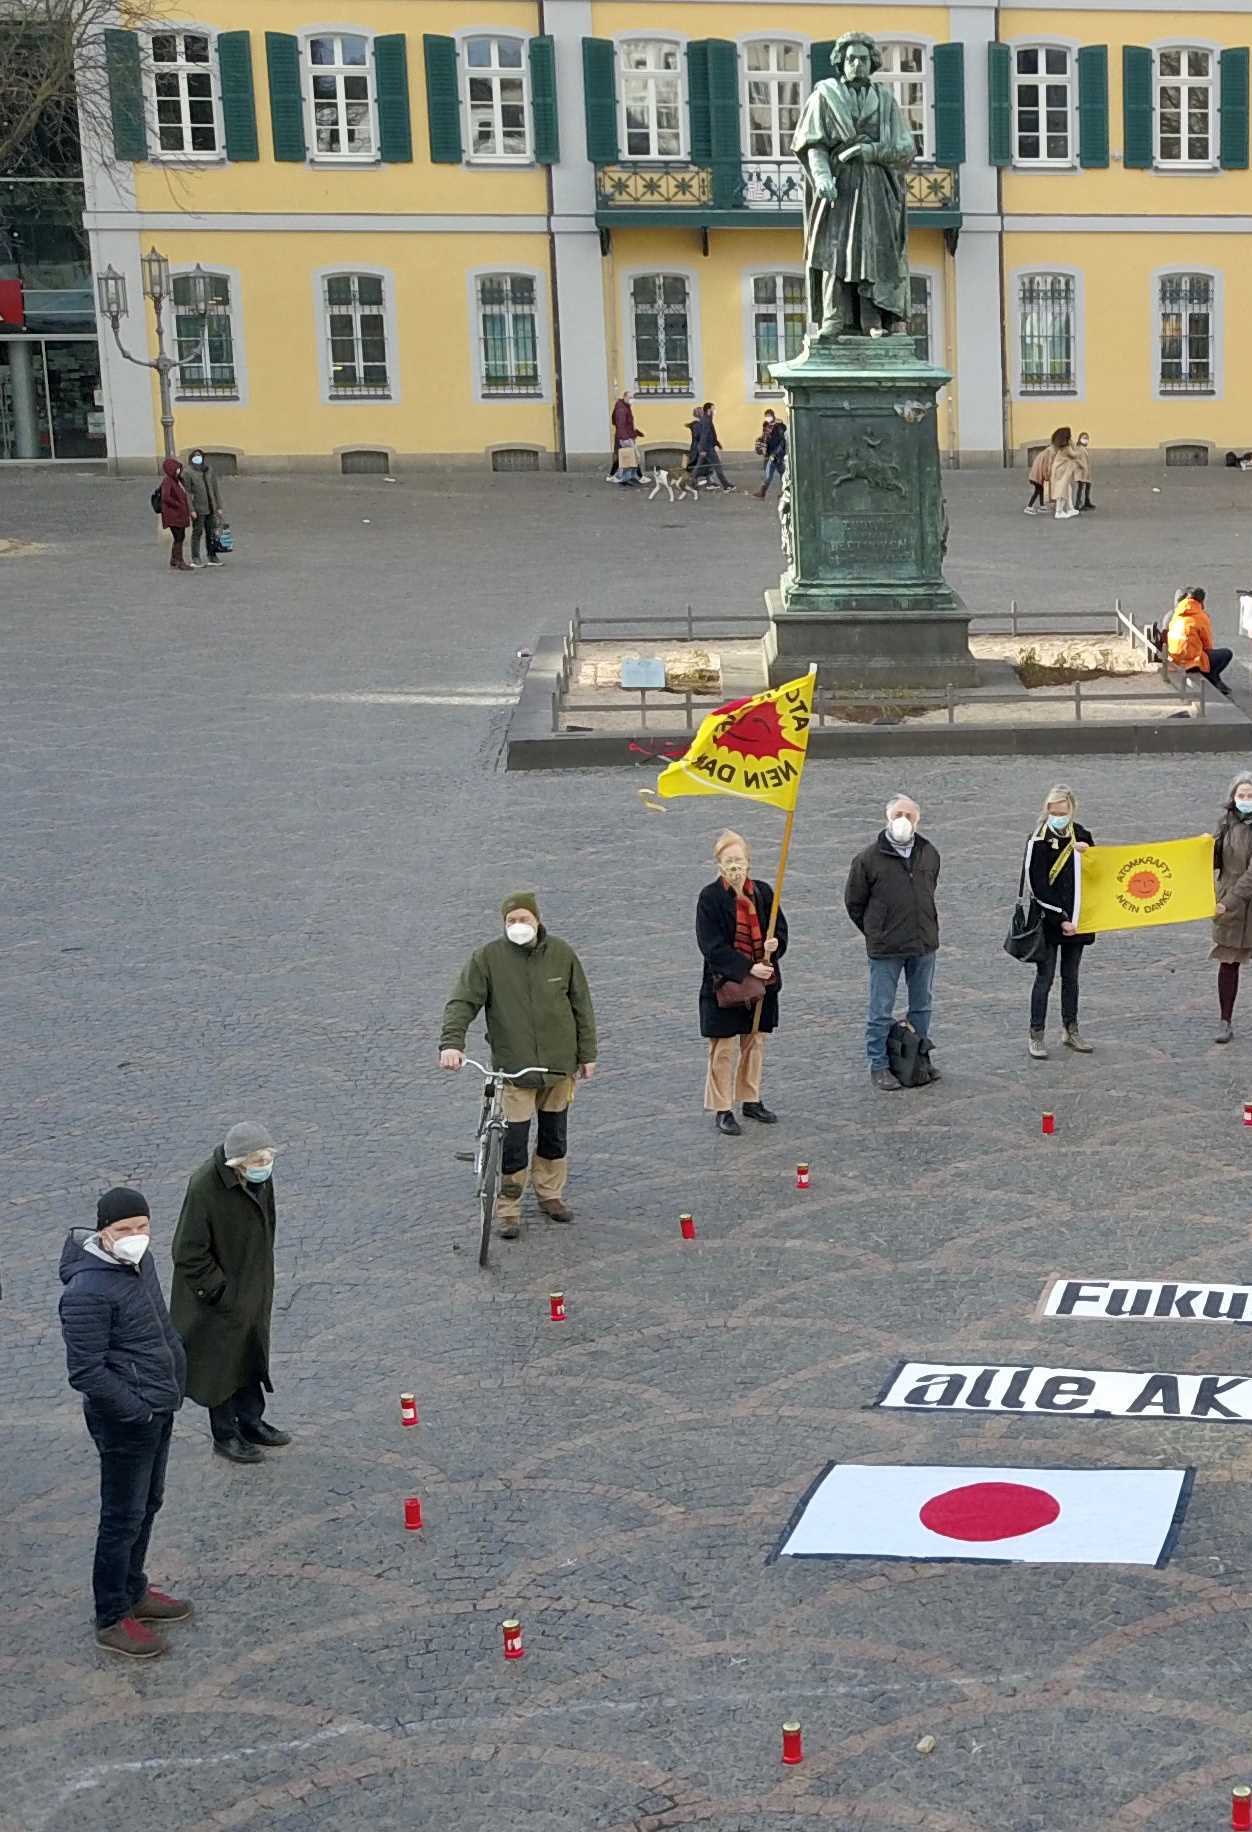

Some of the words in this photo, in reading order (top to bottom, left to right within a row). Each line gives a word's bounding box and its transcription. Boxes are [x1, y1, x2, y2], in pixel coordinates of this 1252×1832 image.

[1116, 856, 1172, 883] ATOMKRAFT?
[1116, 893, 1140, 914] NEIN
[1144, 889, 1172, 914] DANKE
[903, 1367, 1097, 1411] alle
